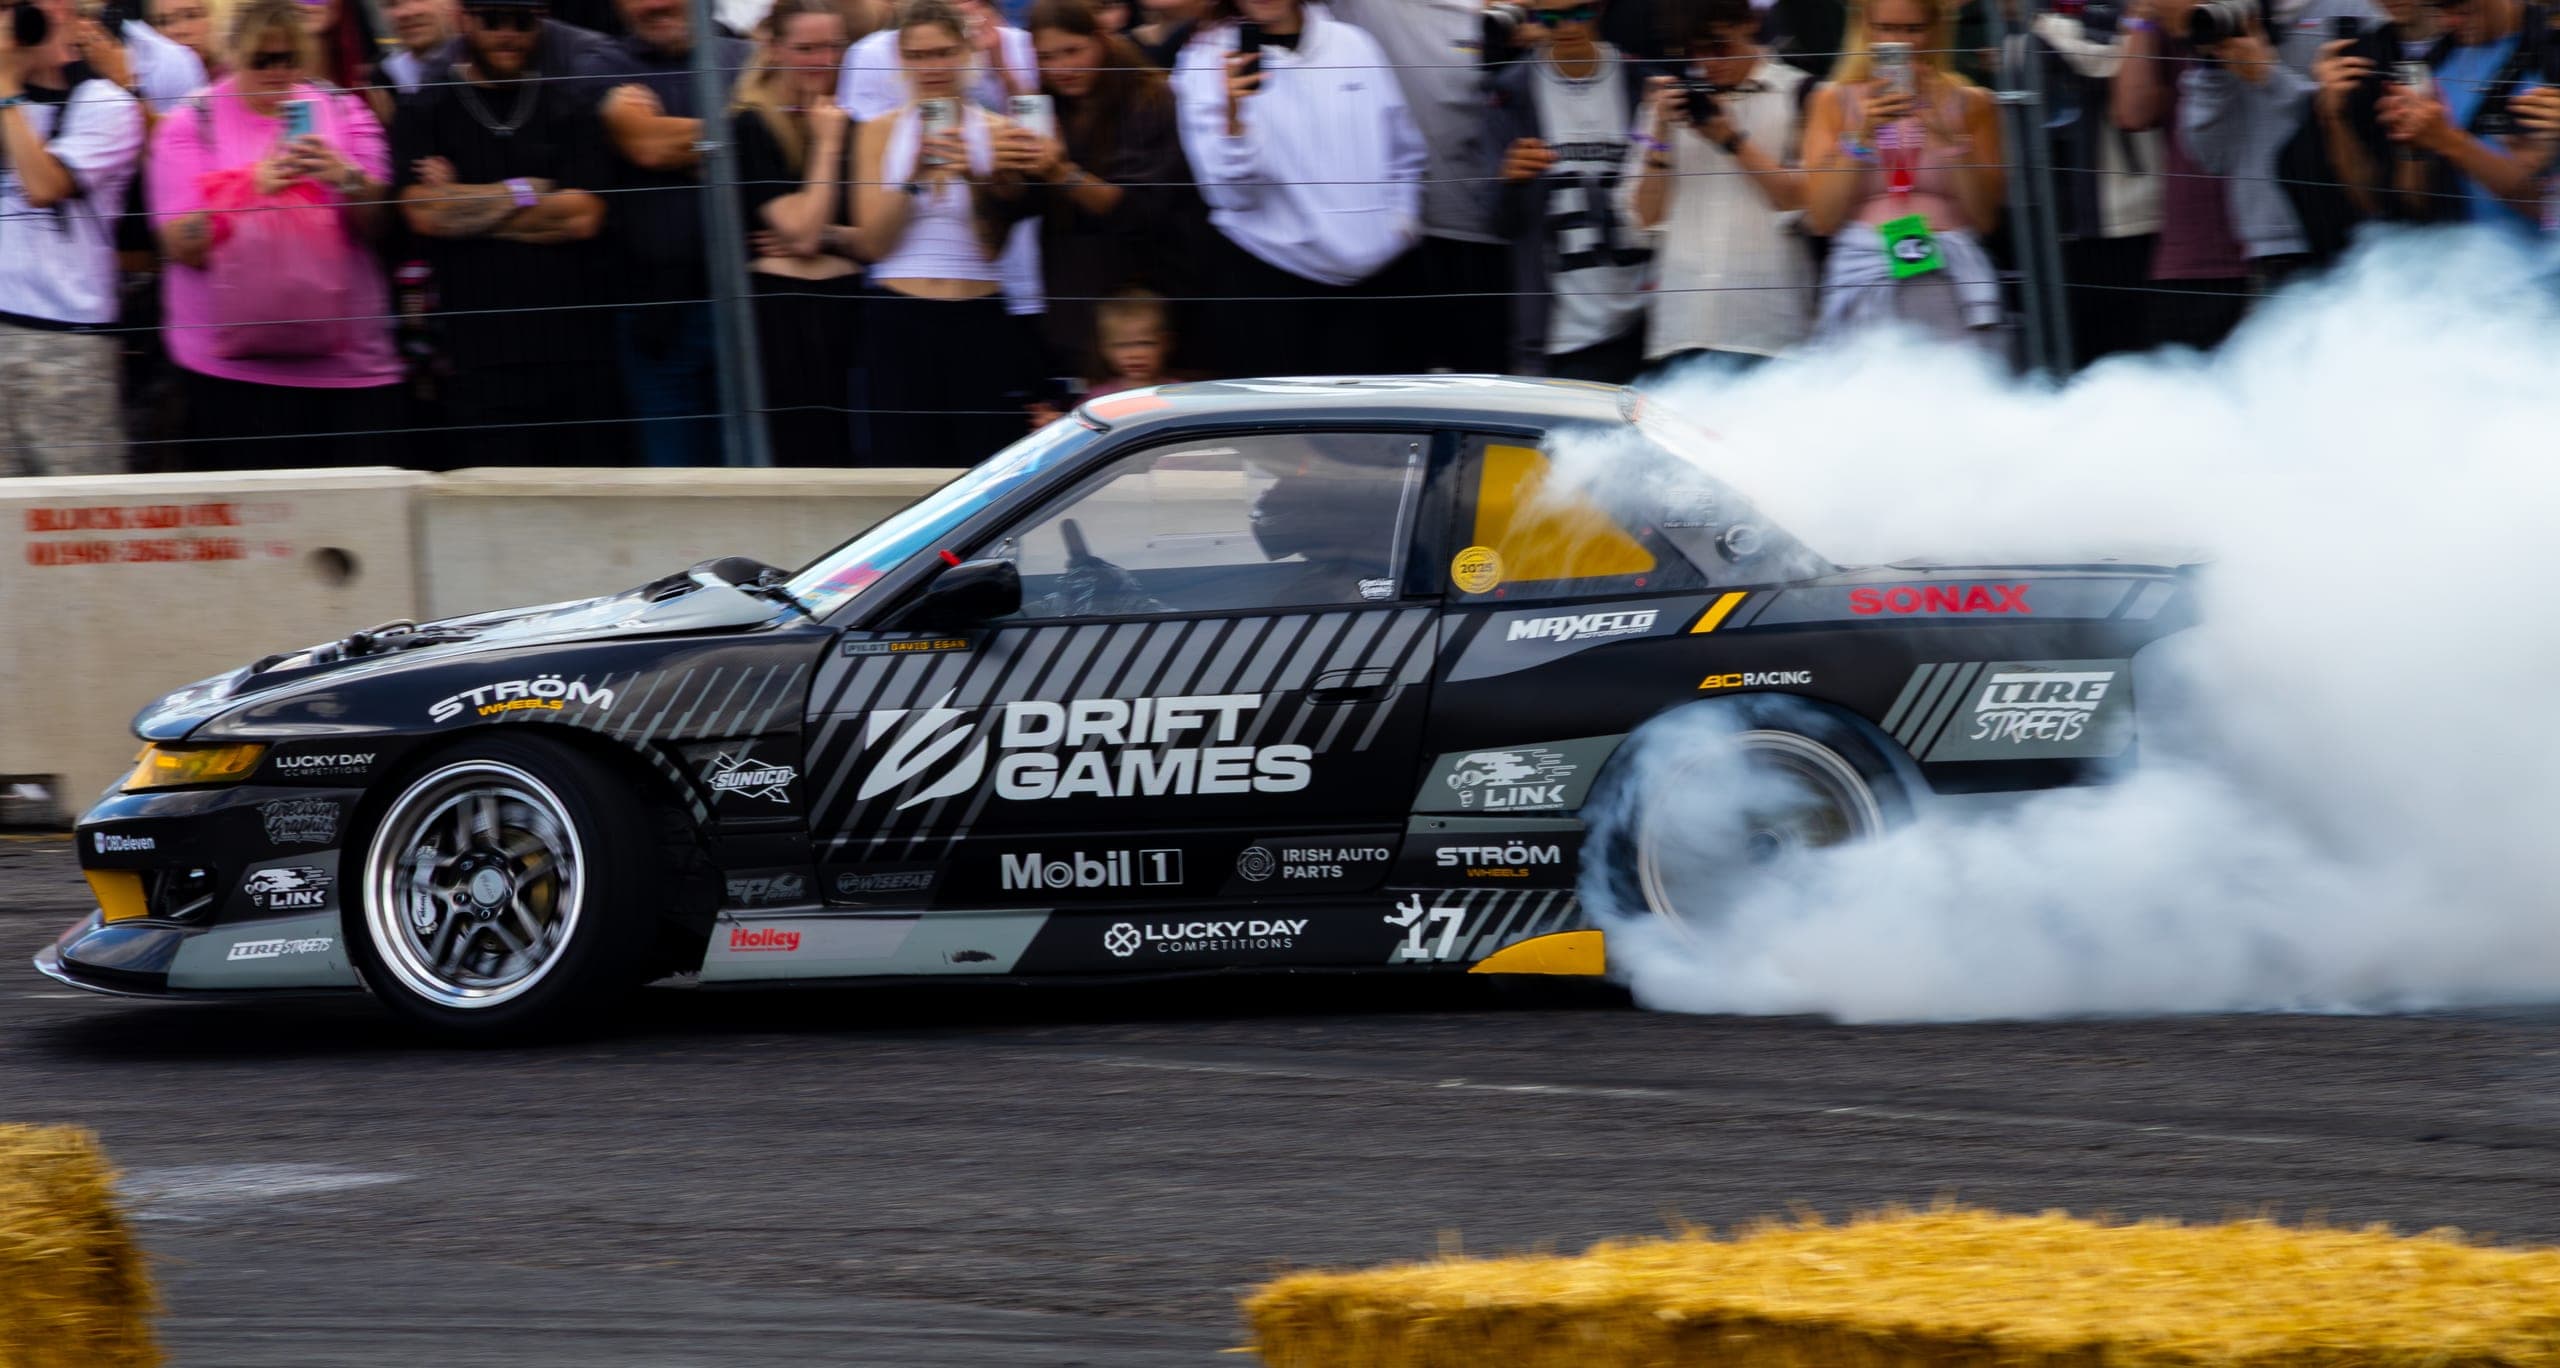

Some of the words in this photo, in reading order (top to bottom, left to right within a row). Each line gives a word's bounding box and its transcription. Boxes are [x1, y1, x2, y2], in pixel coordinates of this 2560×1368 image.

[1849, 584, 2032, 615] SONAX
[1507, 609, 1659, 641] MAXFLO
[891, 641, 930, 652] DAVID
[1743, 670, 1811, 686] RACING
[428, 674, 615, 723] STRÖM
[477, 698, 565, 716] WHEELS
[1000, 694, 1262, 748] DRIFT
[1970, 710, 2090, 744] STREETS
[277, 754, 337, 769] LUCKY
[338, 753, 376, 766] DAY
[284, 766, 368, 777] COMPETITIONS
[716, 769, 791, 787] SUNOCO
[995, 744, 1312, 800] GAMES
[1484, 784, 1566, 807] LINK
[106, 835, 155, 850] OBDeleven
[1282, 848, 1332, 864] IRISH
[1338, 847, 1389, 863] AUTO
[1436, 841, 1561, 867] STRÖM
[1001, 851, 1130, 890] Mobil
[1283, 864, 1343, 880] PARTS
[1466, 868, 1529, 877] WHEELS
[270, 890, 326, 906] LINK
[731, 928, 800, 950] Holley
[1145, 921, 1247, 941] LUCKY
[1248, 918, 1308, 937] DAY
[1401, 908, 1466, 959] 17
[1157, 937, 1292, 954] COMPETITIONS
